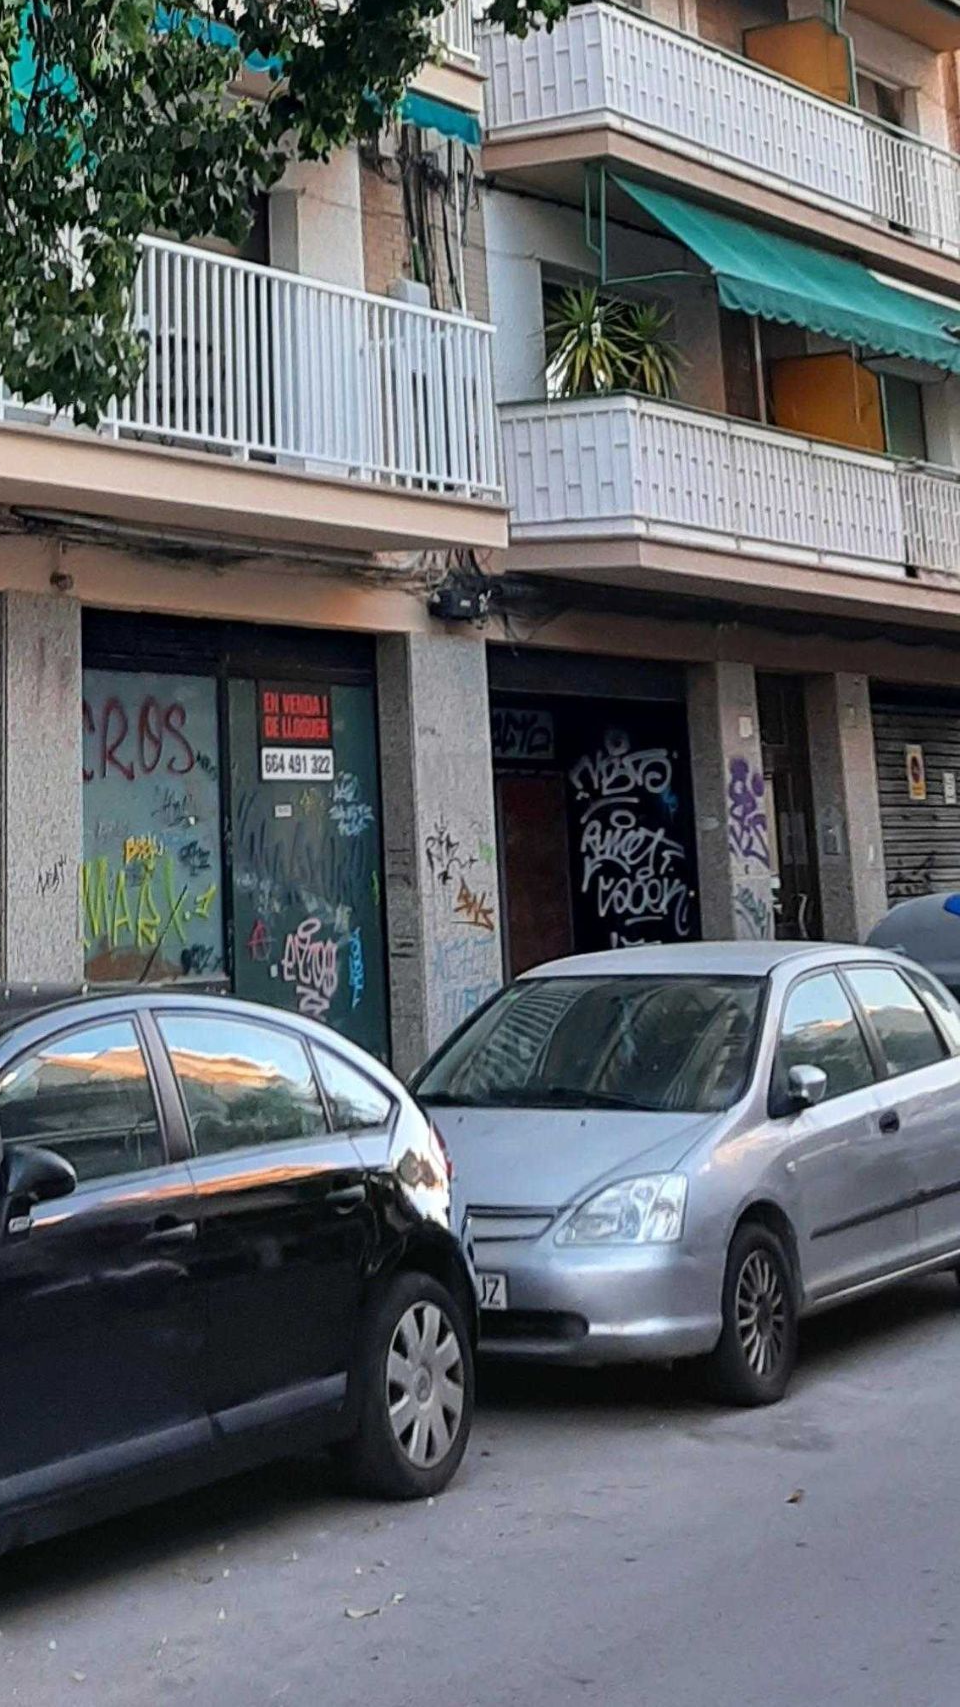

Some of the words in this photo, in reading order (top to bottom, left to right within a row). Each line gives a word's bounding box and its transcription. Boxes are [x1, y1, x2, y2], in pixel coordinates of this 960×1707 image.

[282, 693, 320, 715] VENDA
[265, 715, 279, 738] DE
[282, 715, 330, 740] LLOGUER
[264, 754, 285, 774] 664
[288, 754, 308, 774] 491
[310, 754, 331, 774] 322
